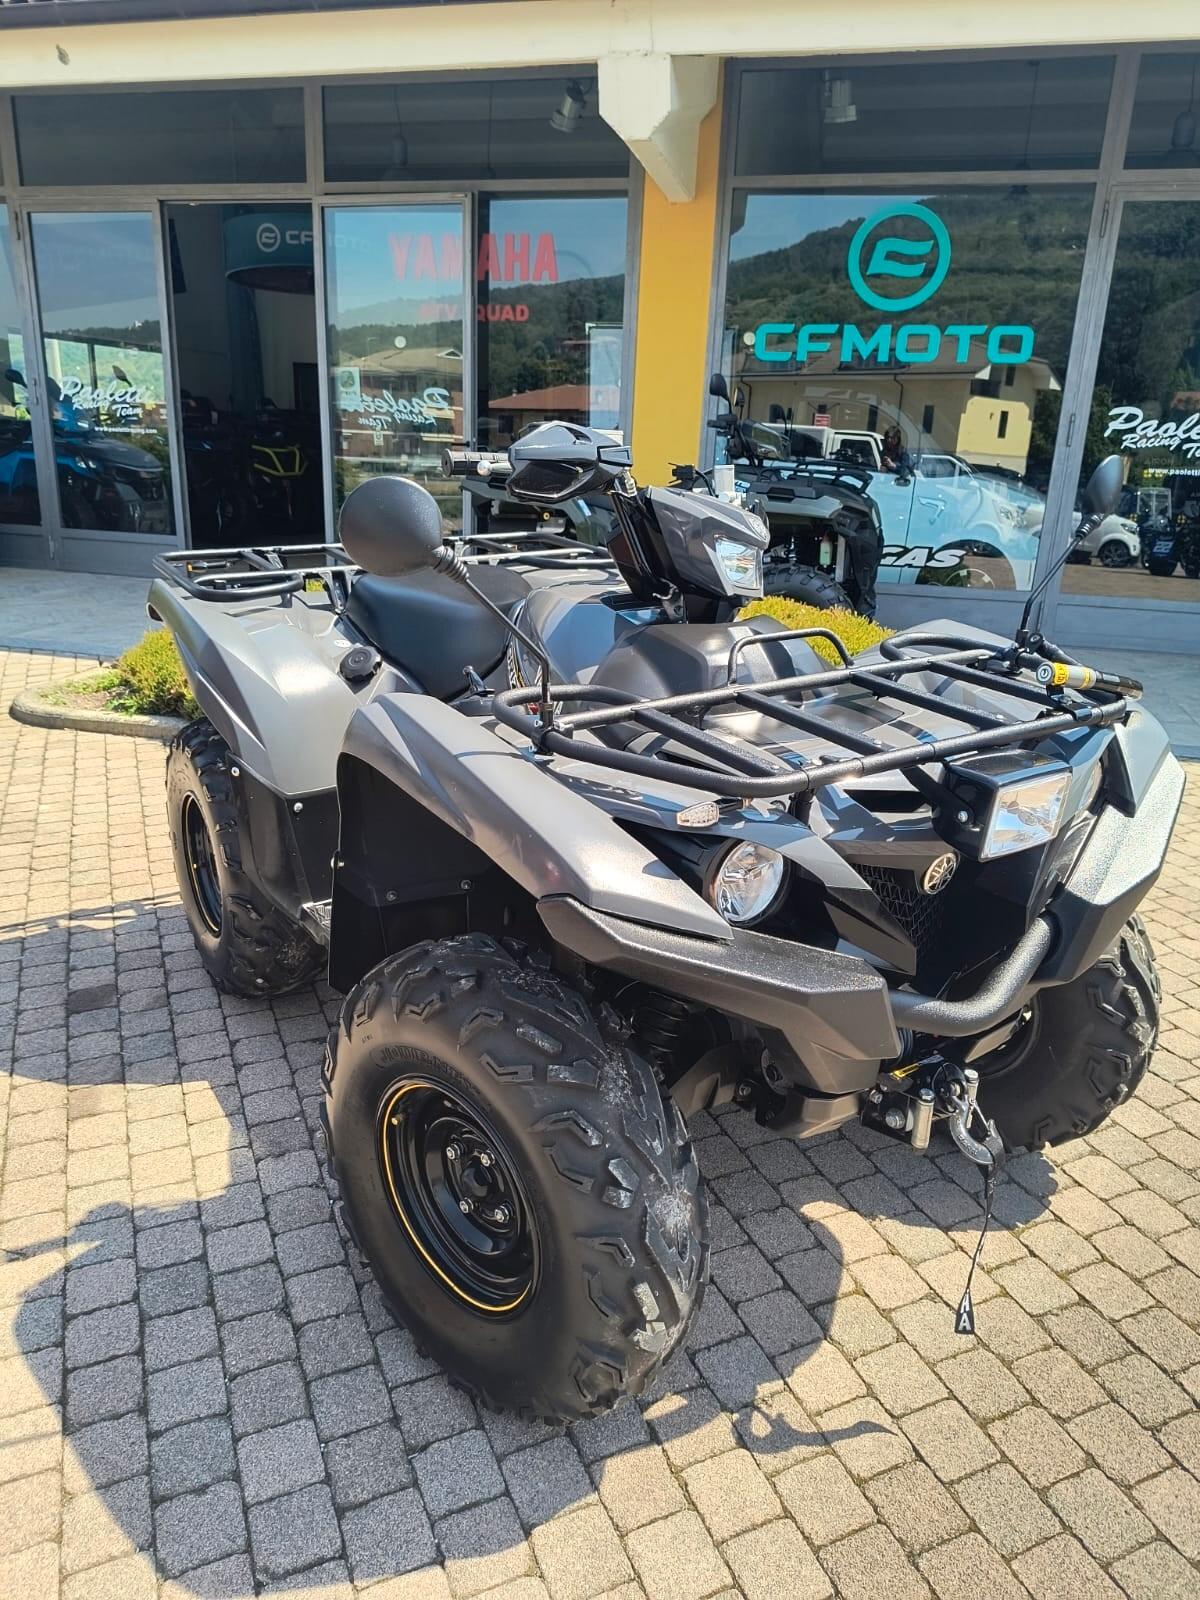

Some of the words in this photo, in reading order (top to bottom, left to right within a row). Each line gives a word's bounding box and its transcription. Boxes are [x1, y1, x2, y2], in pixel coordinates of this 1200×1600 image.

[753, 323, 1035, 364] CFMOTO
[111, 403, 145, 418] Team
[1120, 433, 1181, 451] Racing
